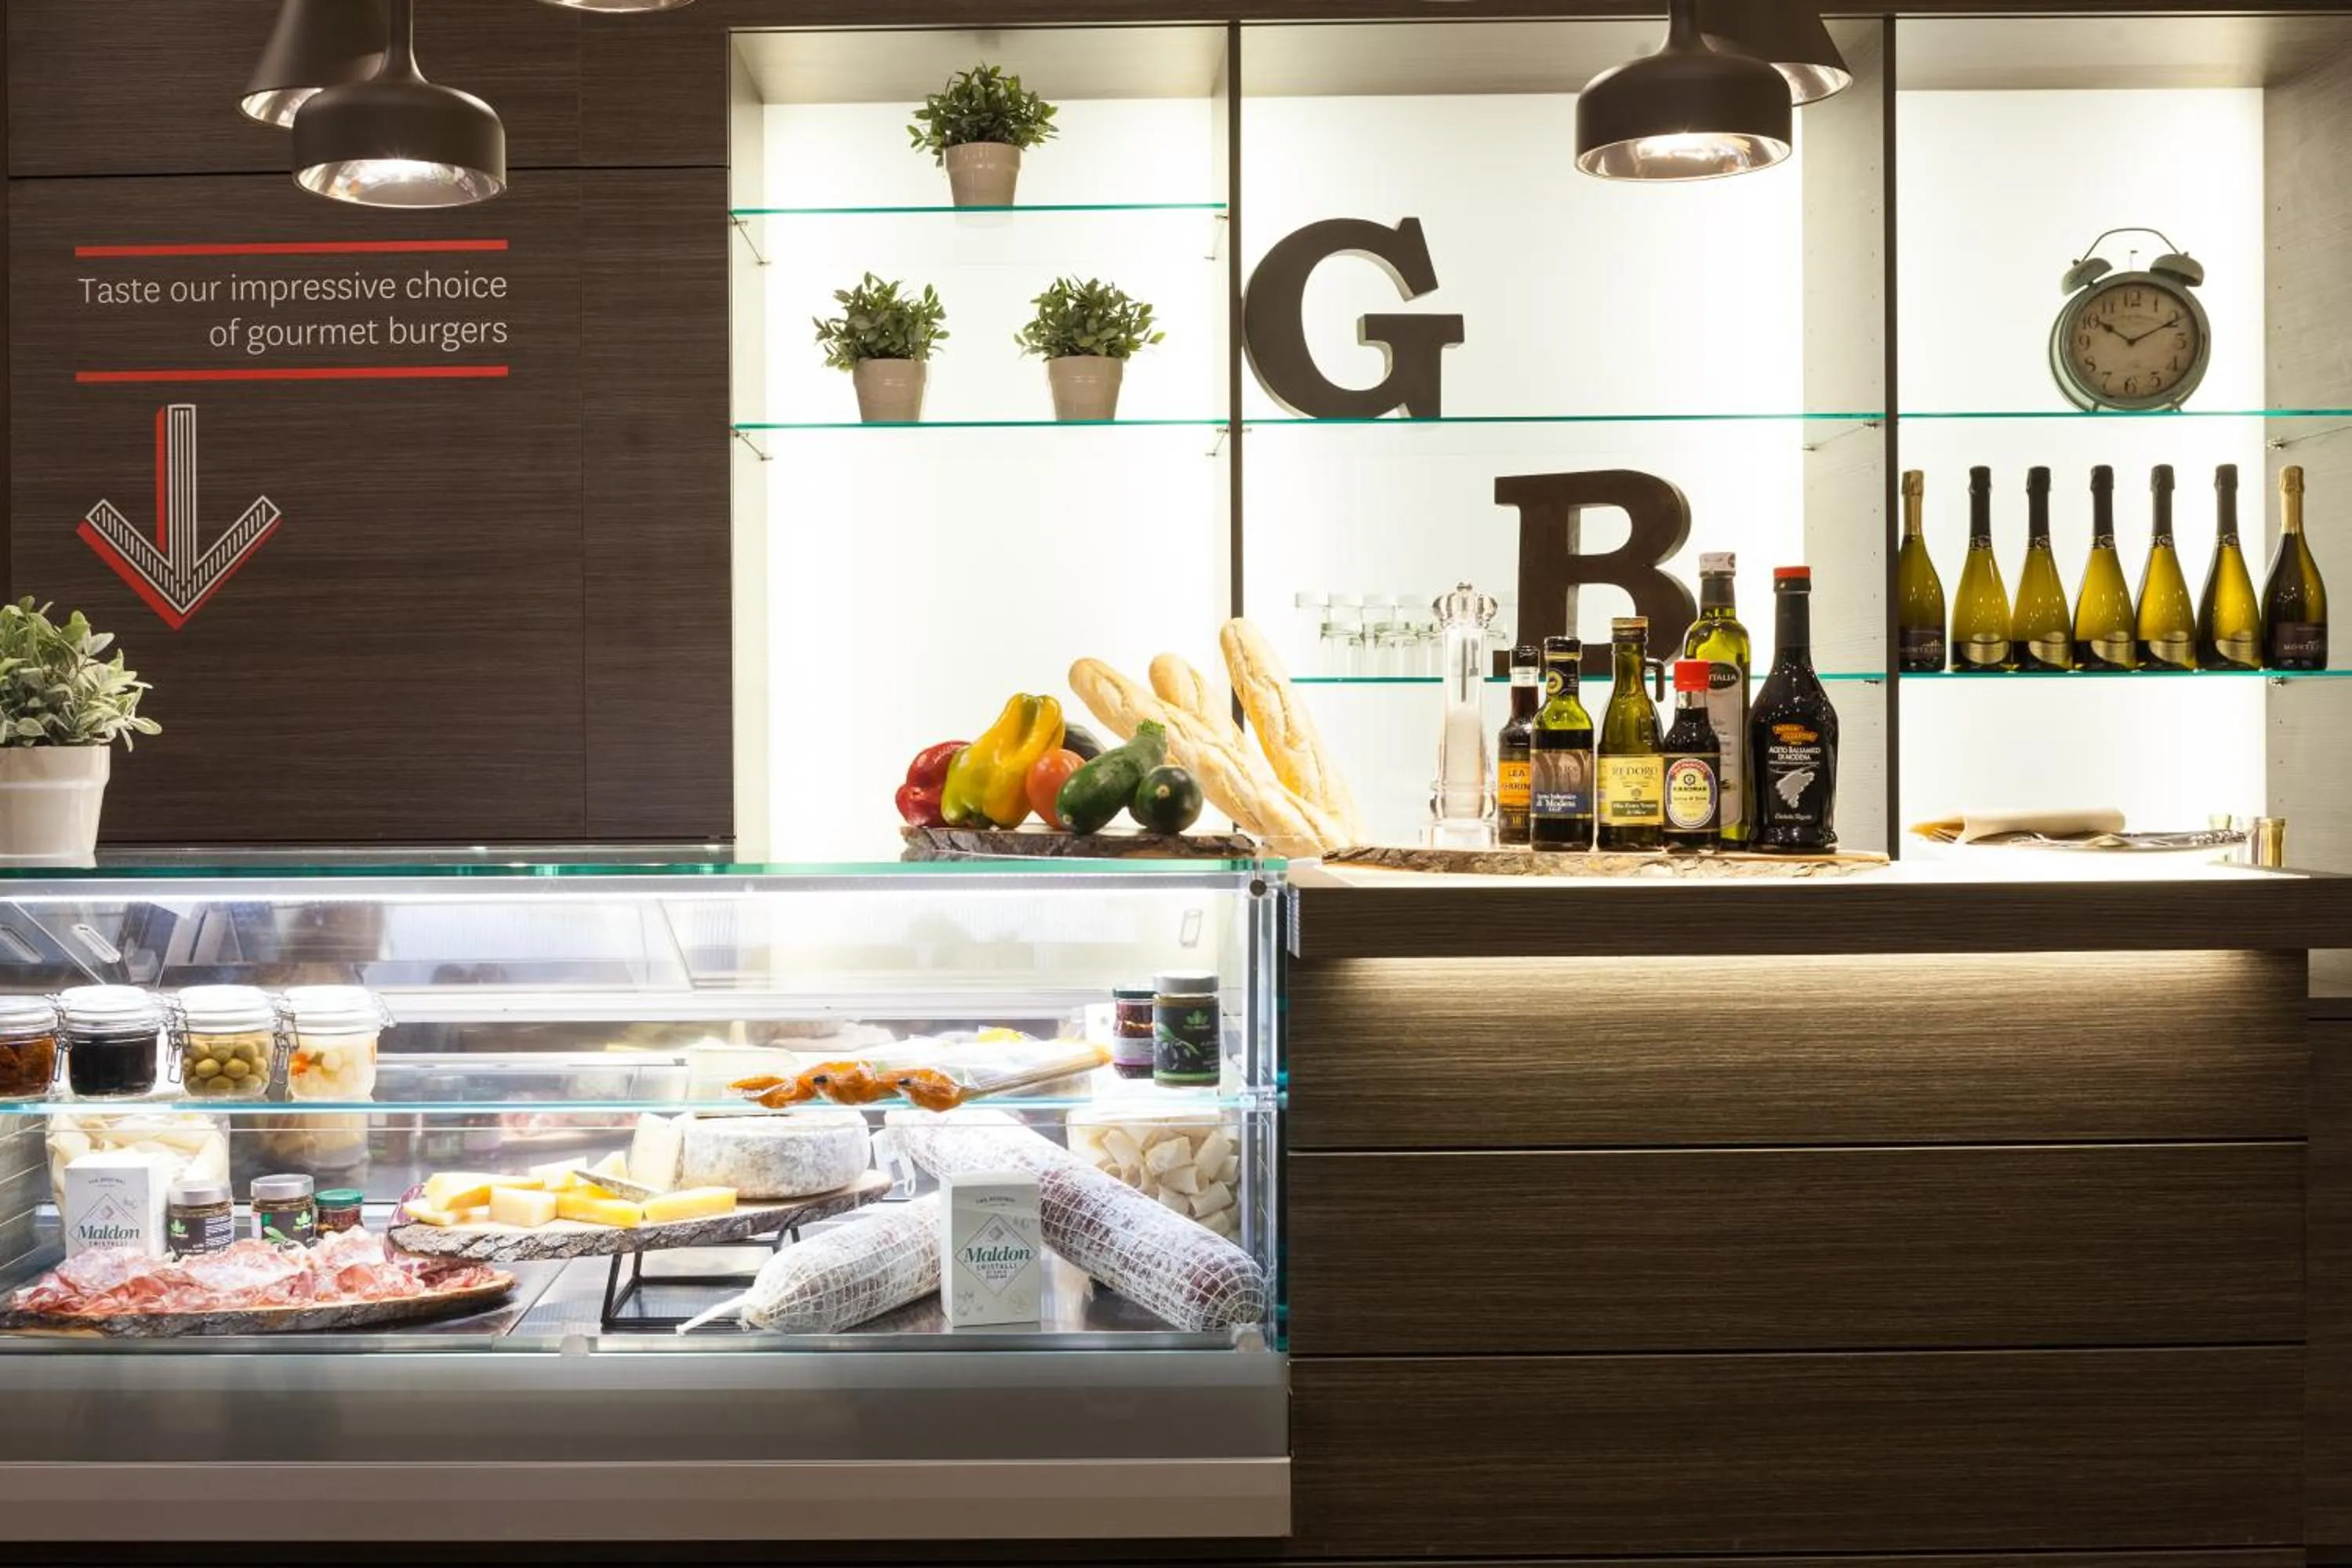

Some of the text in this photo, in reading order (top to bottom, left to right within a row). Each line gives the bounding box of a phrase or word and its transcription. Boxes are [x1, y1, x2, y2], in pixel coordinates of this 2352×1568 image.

[78, 269, 508, 308] Taste our impressive choice
[2124, 289, 2142, 307] 12
[1242, 217, 1465, 420] G
[2082, 314, 2100, 330] 10
[209, 315, 508, 356] of gourmet burgers
[2078, 335, 2091, 350] 9
[2175, 332, 2187, 350] 3
[2084, 356, 2097, 373] 8
[2101, 371, 2113, 390] 7
[2124, 376, 2137, 394] 6
[2151, 371, 2161, 388] 5
[1493, 469, 1699, 677] B
[78, 1225, 140, 1240] Maldon
[964, 1246, 1030, 1264] Maldon
